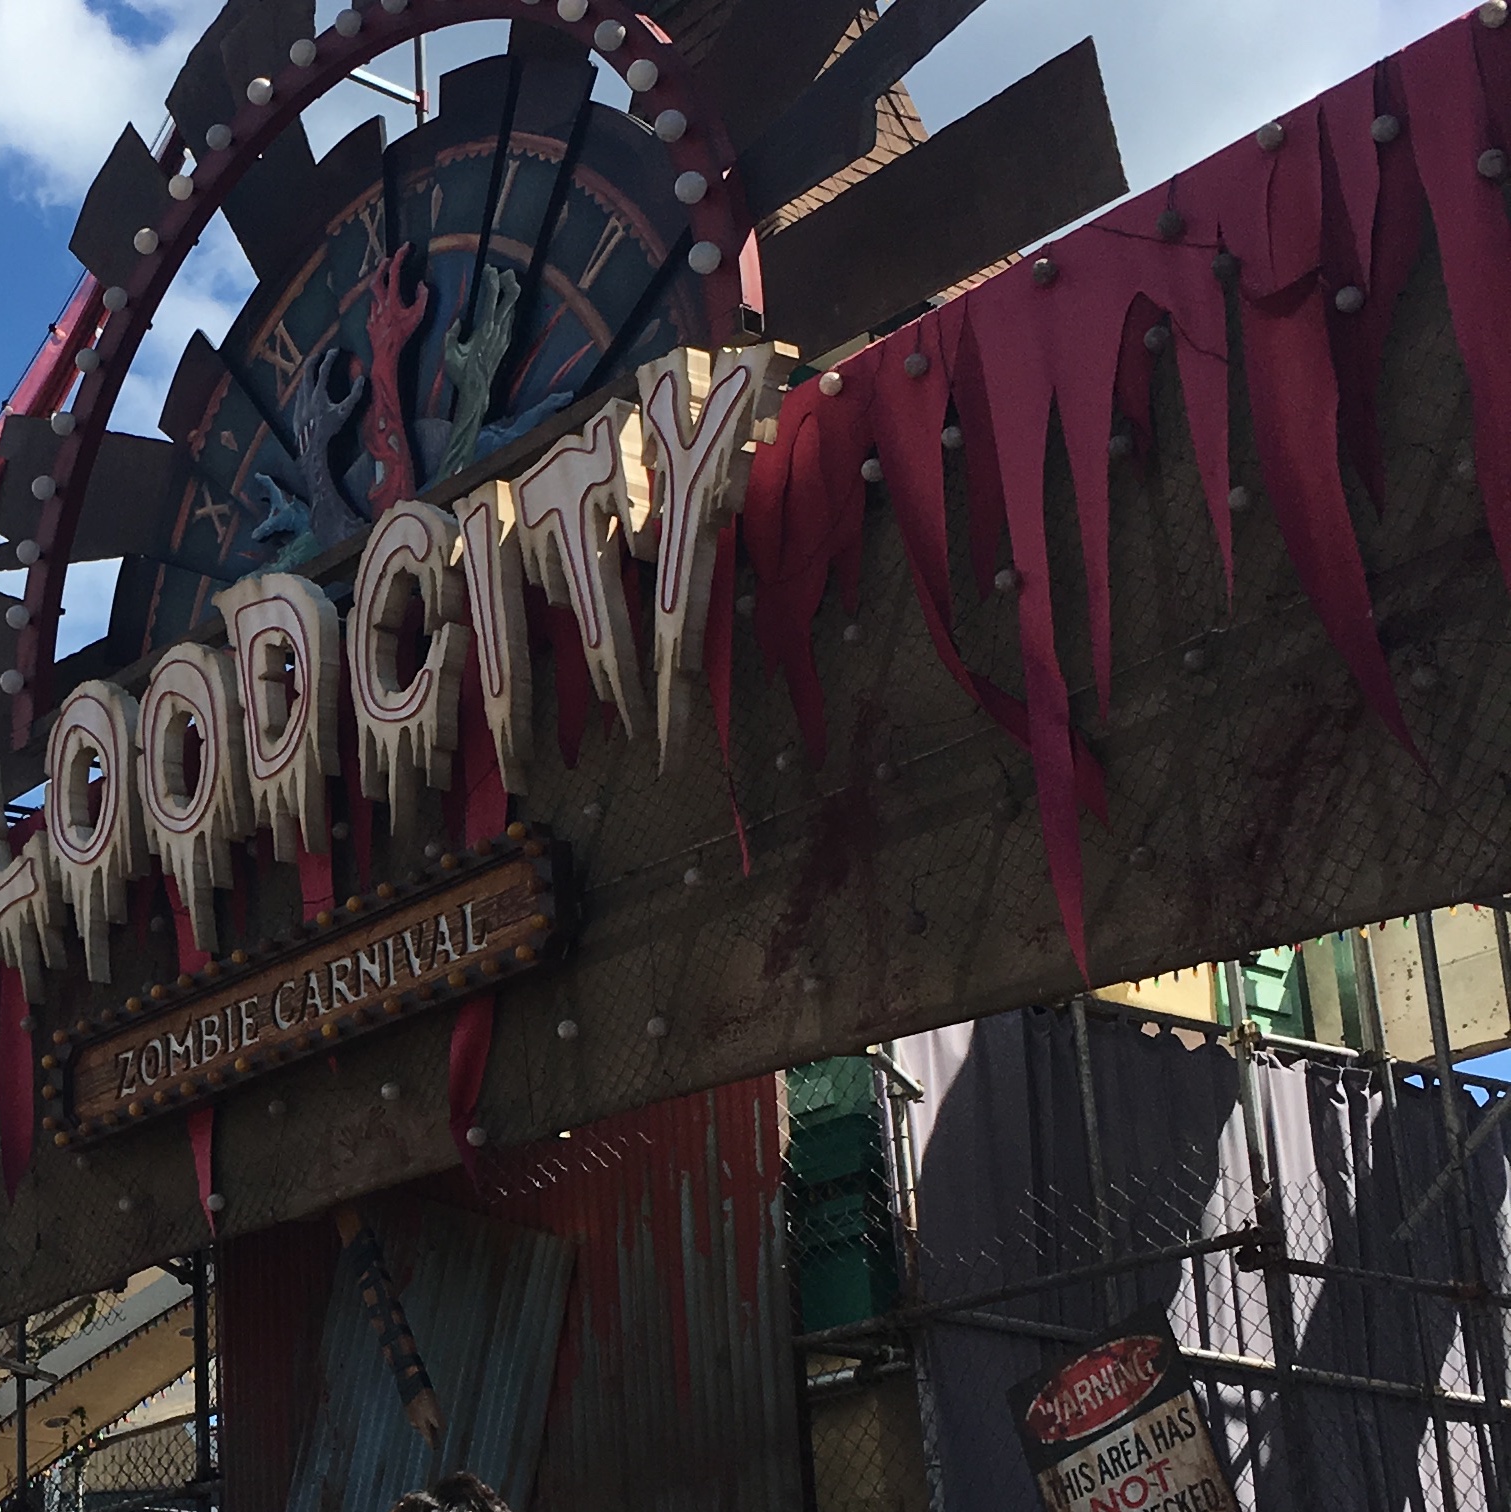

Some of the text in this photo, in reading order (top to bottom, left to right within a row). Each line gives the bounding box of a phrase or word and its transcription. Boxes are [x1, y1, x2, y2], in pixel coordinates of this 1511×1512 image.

[348, 341, 800, 834] CITY
[114, 899, 489, 1099] ZOMBIE CARNIVAL
[1037, 1345, 1155, 1430] WARNING
[1048, 1407, 1196, 1508] THIS AREA HAS
